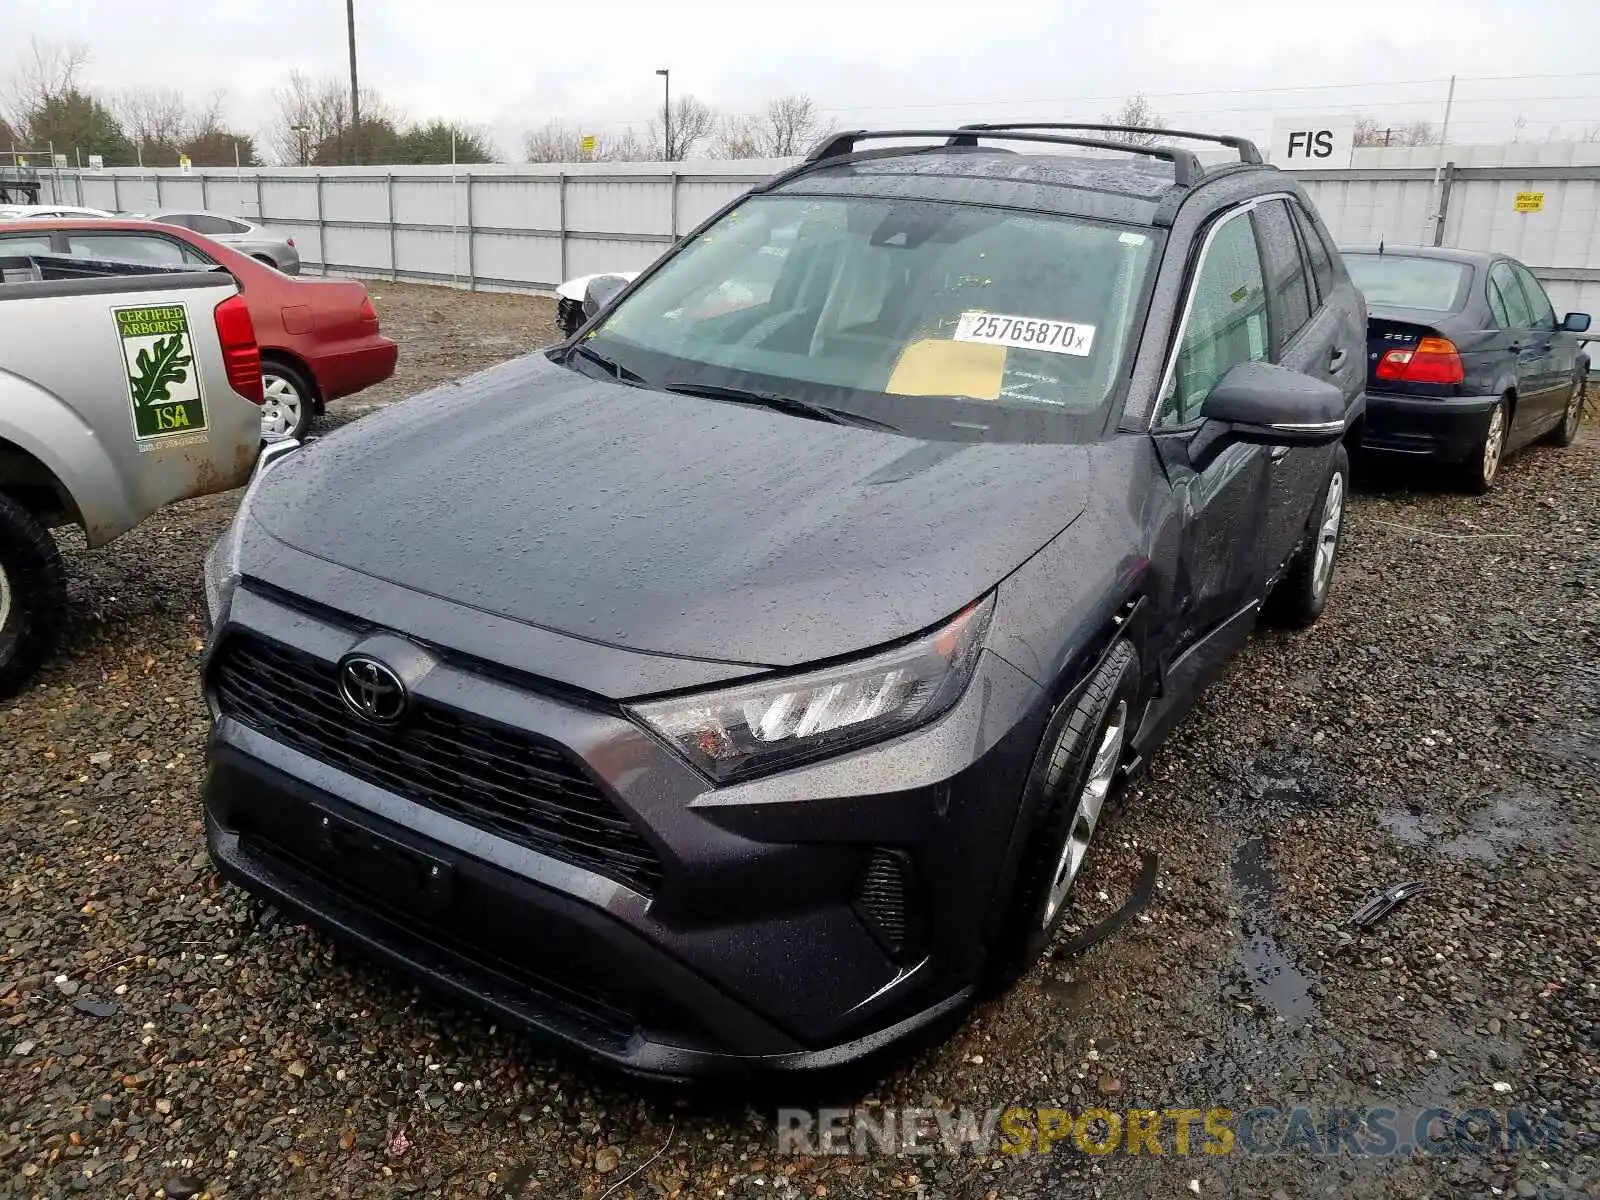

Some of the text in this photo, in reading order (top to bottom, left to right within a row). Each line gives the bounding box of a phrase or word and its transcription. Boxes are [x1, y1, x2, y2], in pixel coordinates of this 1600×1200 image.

[1288, 131, 1333, 158] FIS
[117, 308, 183, 323] CERTIFIED
[123, 320, 185, 335] ARBORIST
[154, 404, 190, 430] ISA
